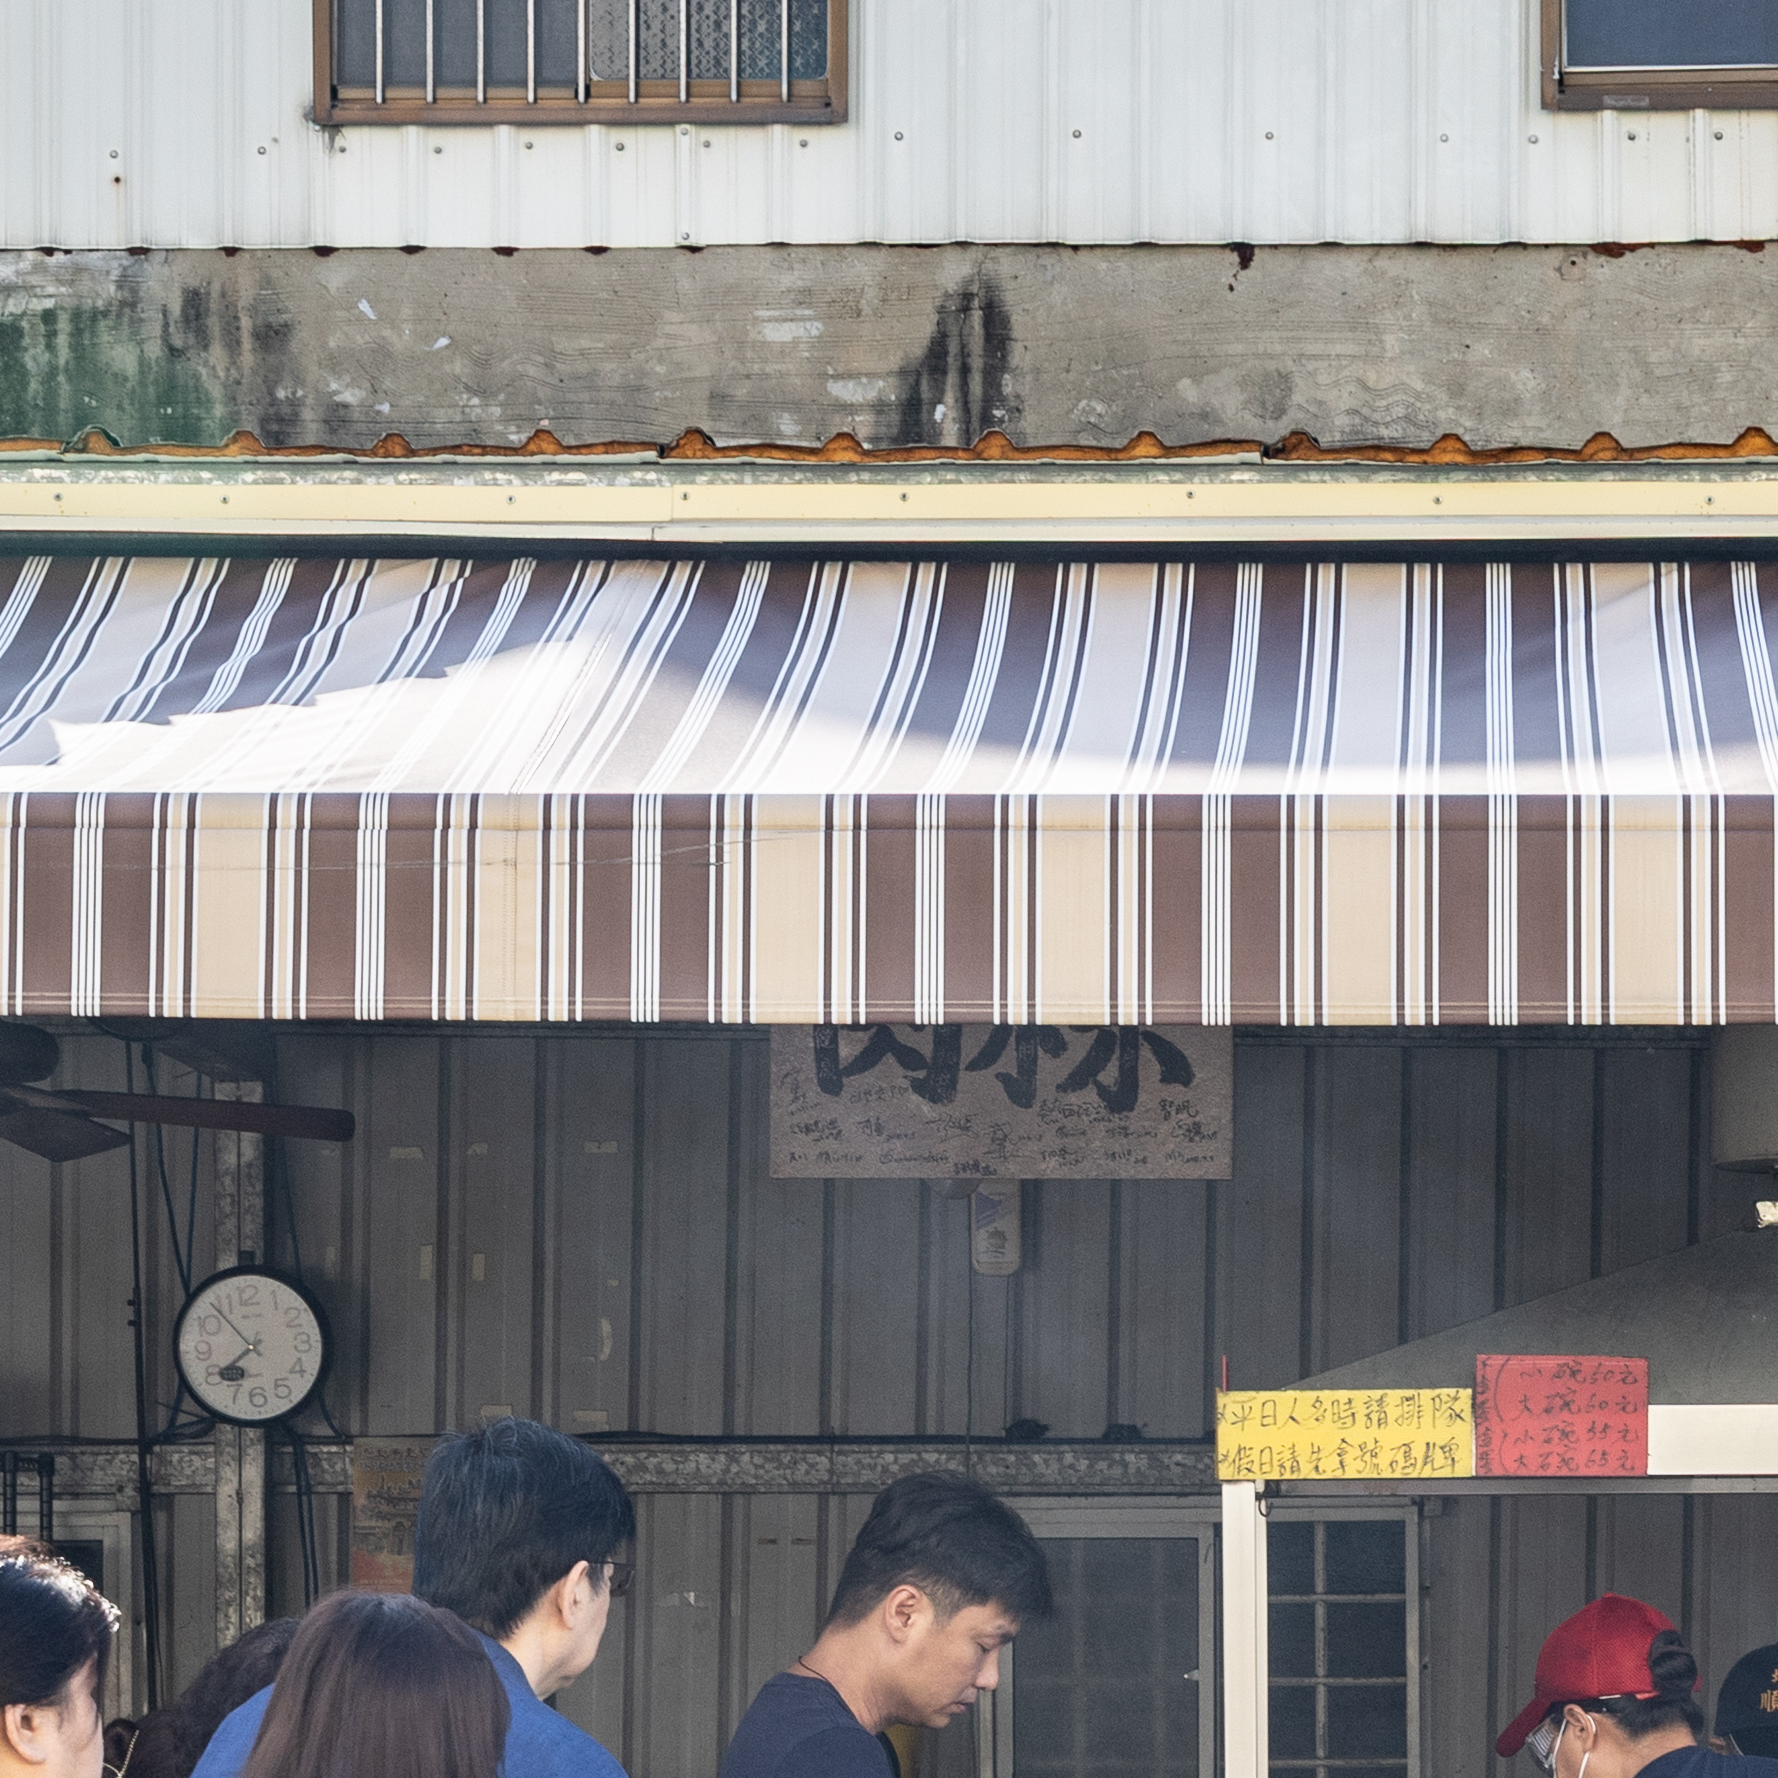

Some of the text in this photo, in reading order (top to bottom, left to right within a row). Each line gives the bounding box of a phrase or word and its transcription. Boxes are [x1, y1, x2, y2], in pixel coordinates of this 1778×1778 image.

[238, 1285, 260, 1306] 12
[271, 1290, 279, 1310] 1
[198, 1314, 222, 1336] 10
[284, 1307, 303, 1328] 2
[195, 1340, 212, 1361] 9
[294, 1332, 312, 1354] 3
[205, 1364, 222, 1386] 8
[289, 1356, 307, 1378] 4
[226, 1384, 242, 1405] 7
[249, 1386, 268, 1408] 6
[273, 1378, 292, 1399] 5
[1230, 1391, 1469, 1431] 平日人多時請排隊
[1230, 1437, 1462, 1479] 假日請先拿號碼牌
